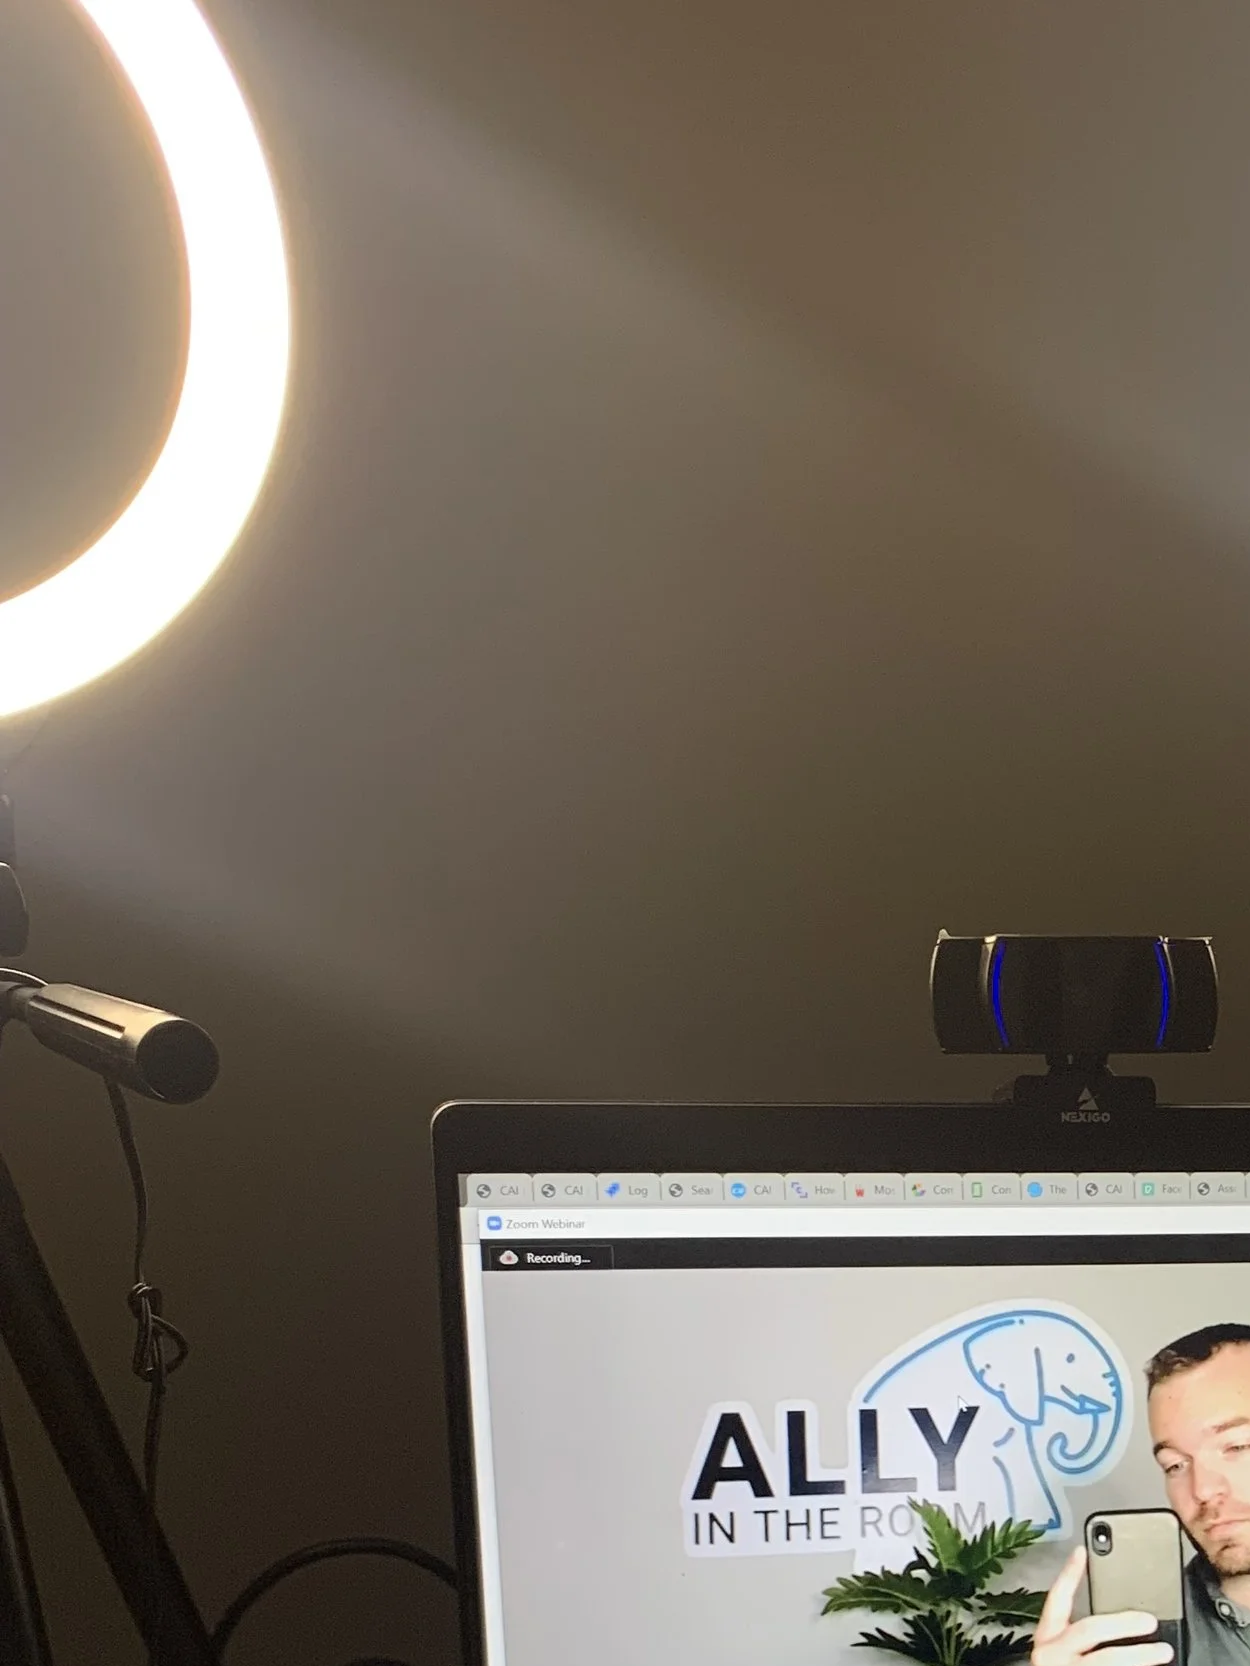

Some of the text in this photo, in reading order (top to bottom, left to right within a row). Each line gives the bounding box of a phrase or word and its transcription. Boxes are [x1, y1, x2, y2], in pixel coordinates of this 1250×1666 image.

[1060, 1111, 1111, 1123] NEXIGO
[505, 1217, 586, 1230] Zoom Webinar
[691, 1404, 980, 1501] ALLY
[693, 1510, 736, 1546] IN
[753, 1506, 841, 1542] THE
